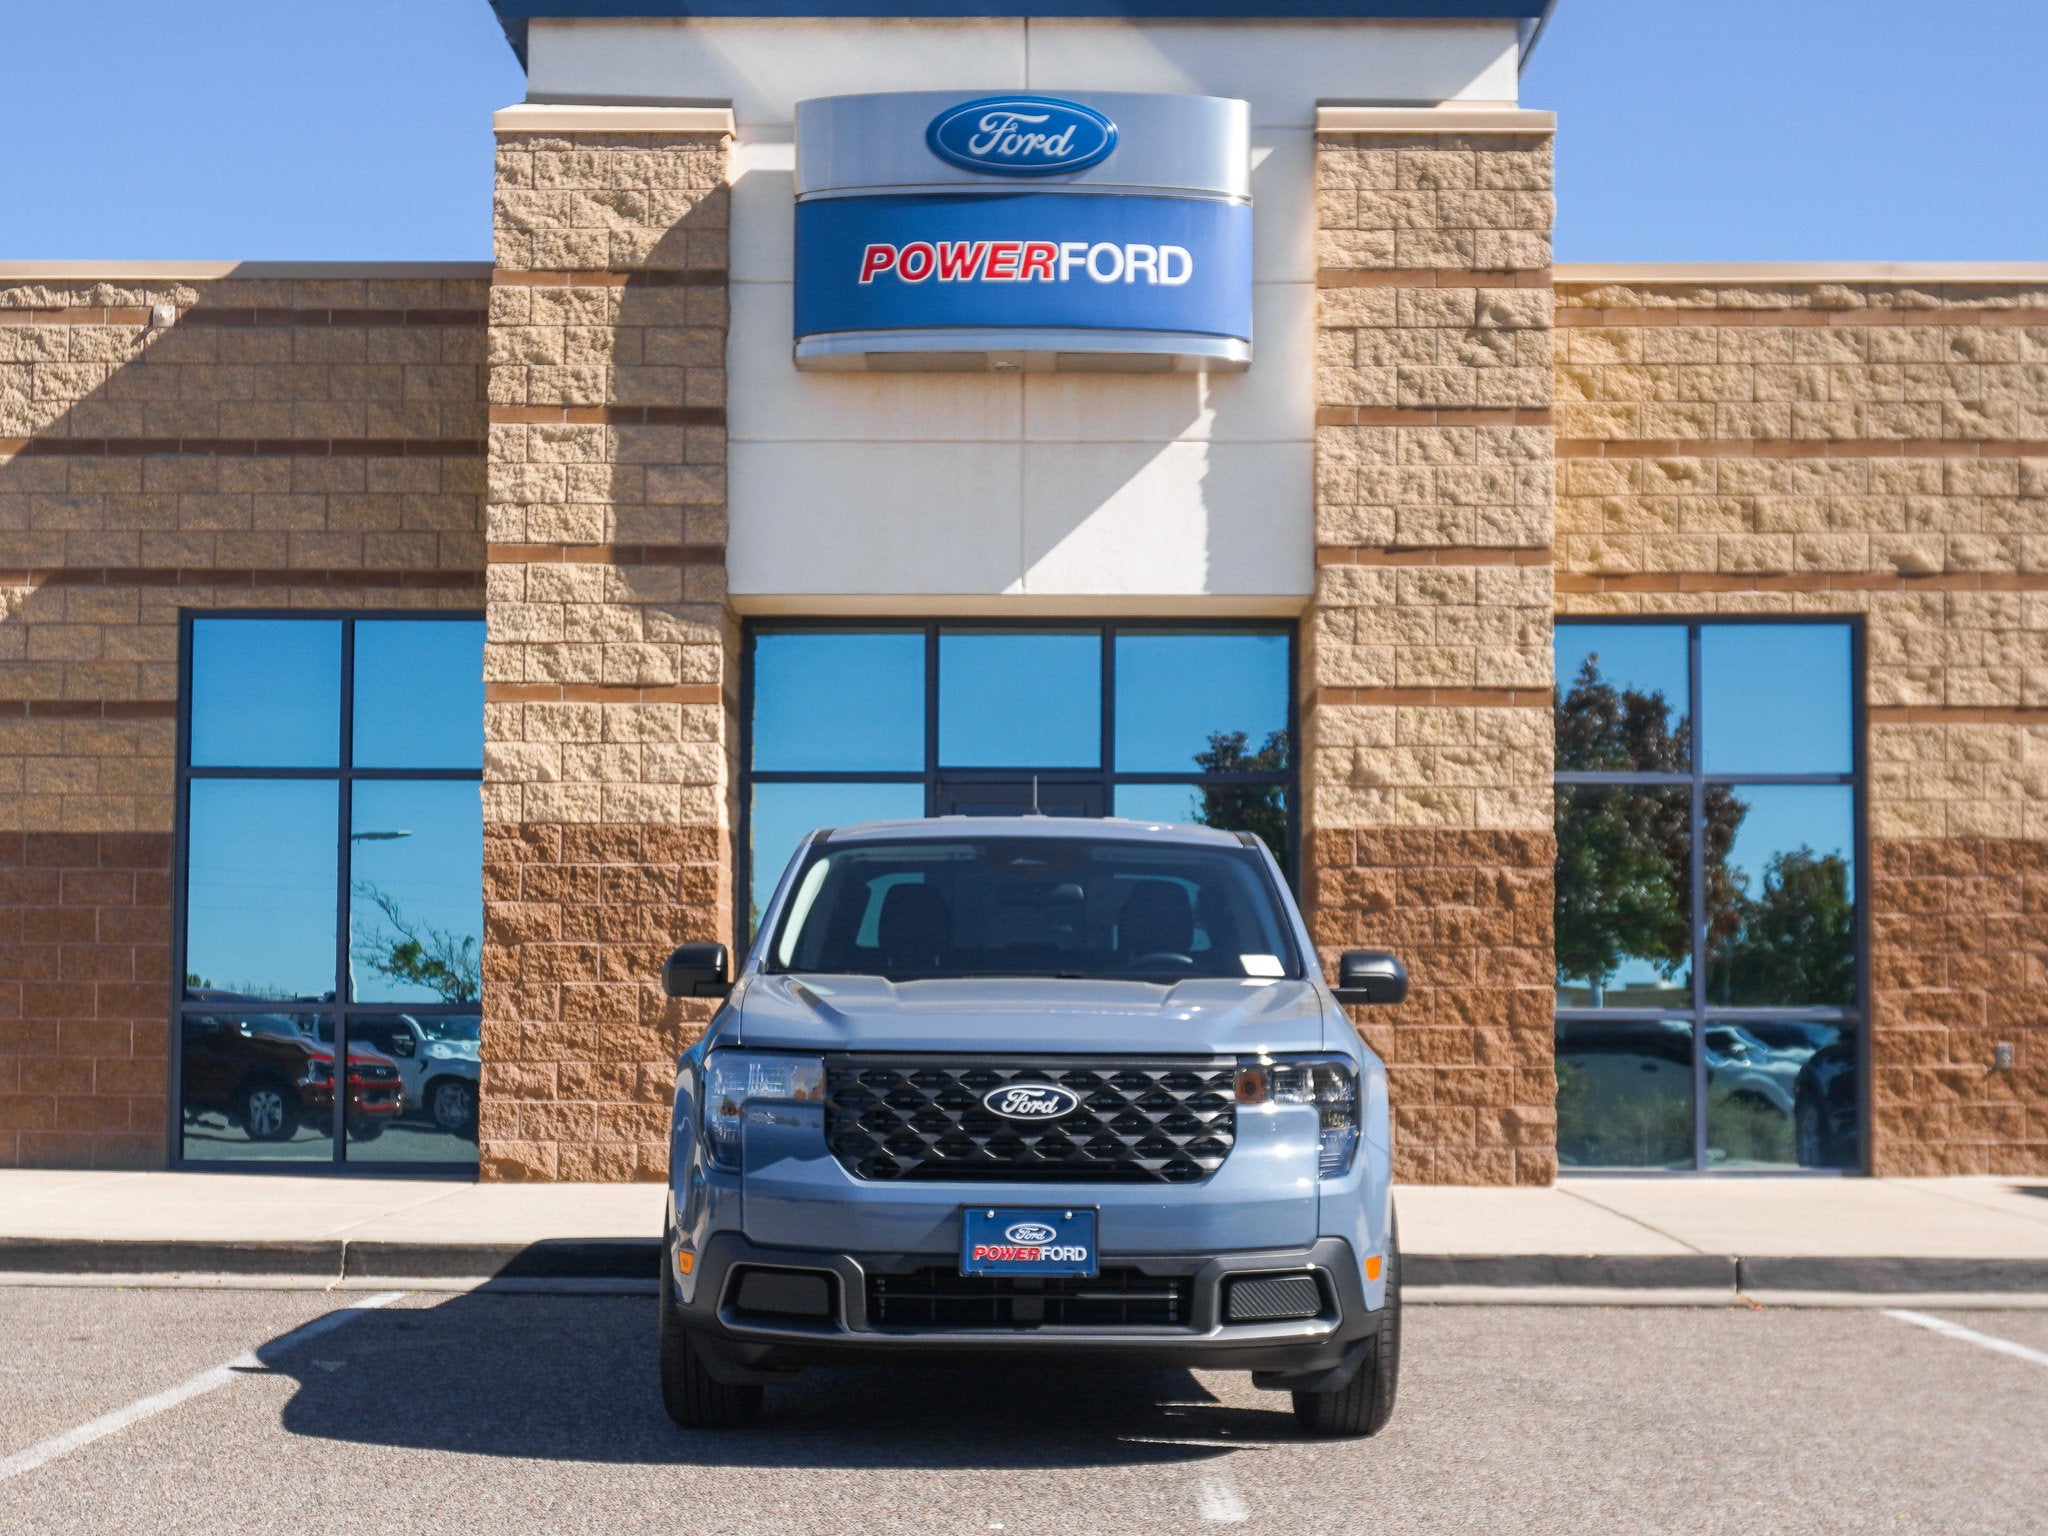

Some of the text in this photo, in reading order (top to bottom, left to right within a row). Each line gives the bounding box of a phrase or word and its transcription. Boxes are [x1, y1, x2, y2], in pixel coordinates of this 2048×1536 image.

[968, 111, 1077, 156] Ford
[1001, 1089, 1060, 1114] Ford
[1014, 1226, 1046, 1241] Ford
